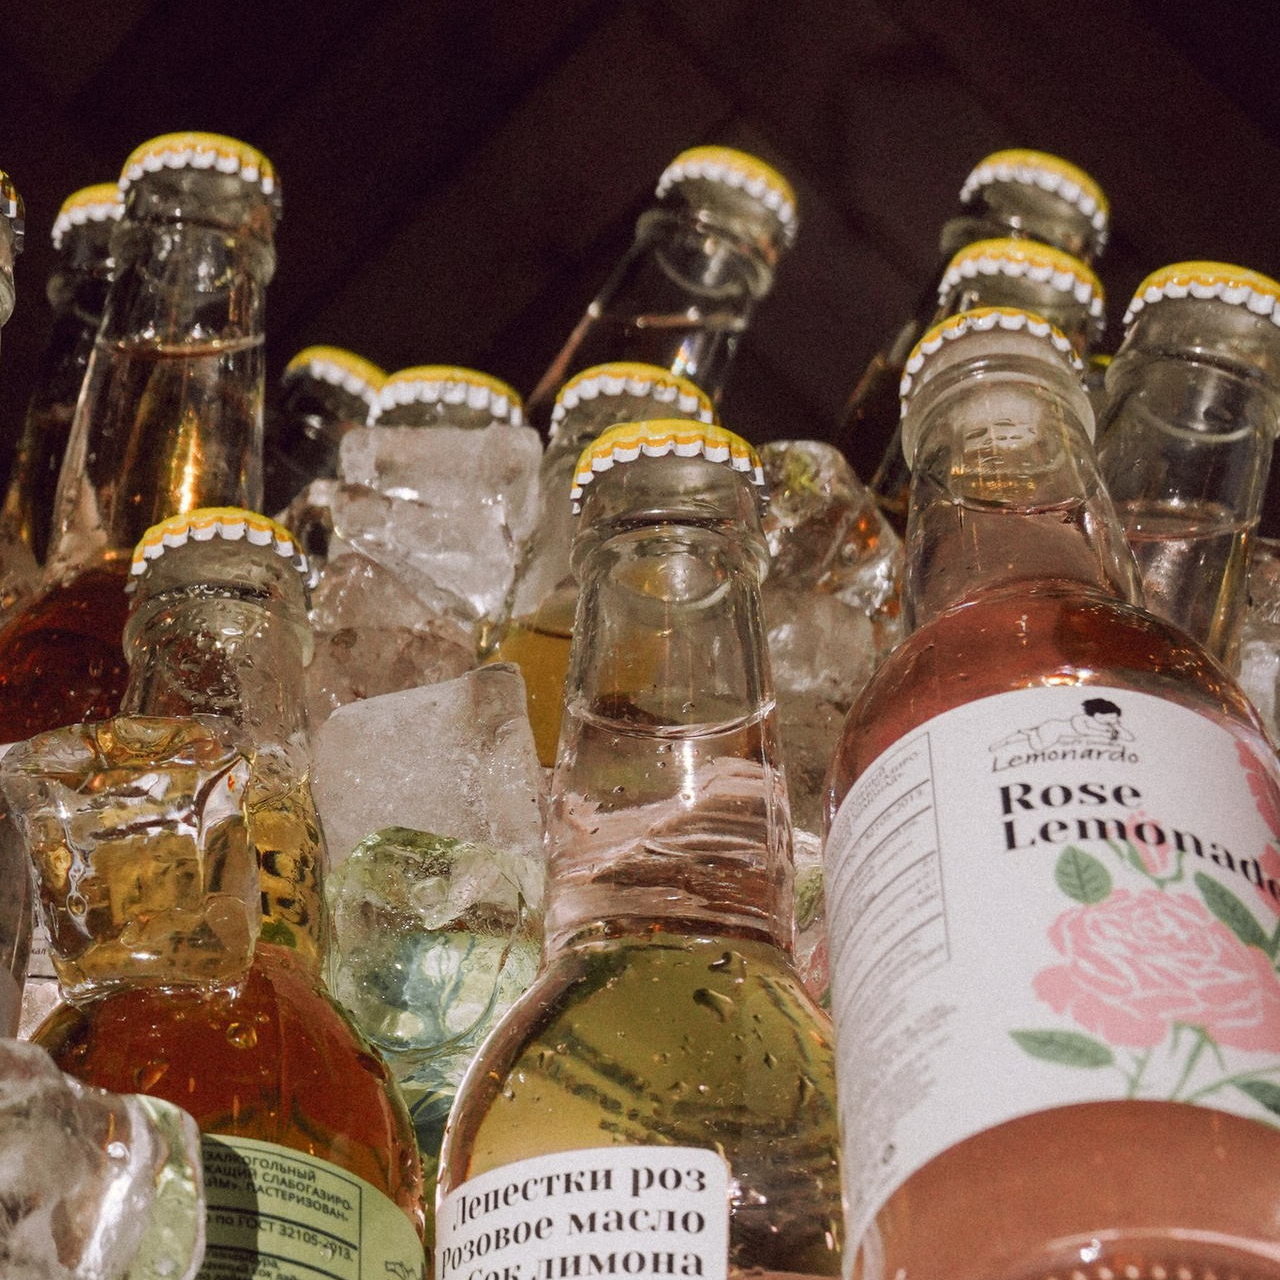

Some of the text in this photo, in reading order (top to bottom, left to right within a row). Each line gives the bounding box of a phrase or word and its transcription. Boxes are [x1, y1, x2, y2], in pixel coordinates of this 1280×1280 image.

[991, 747, 1139, 773] Lemonardo
[999, 781, 1143, 816] Rose
[205, 1150, 317, 1183] ЗАЛКОГОЛЬНЫЙ
[246, 1182, 349, 1222] ПАСТЕРИЗОВАН-
[262, 1171, 354, 1211] СЛАБОГАЗИРО-
[452, 1165, 706, 1232] Лепестки роз
[238, 1216, 275, 1232] ГОСТ
[441, 1208, 705, 1280] Розовое масло
